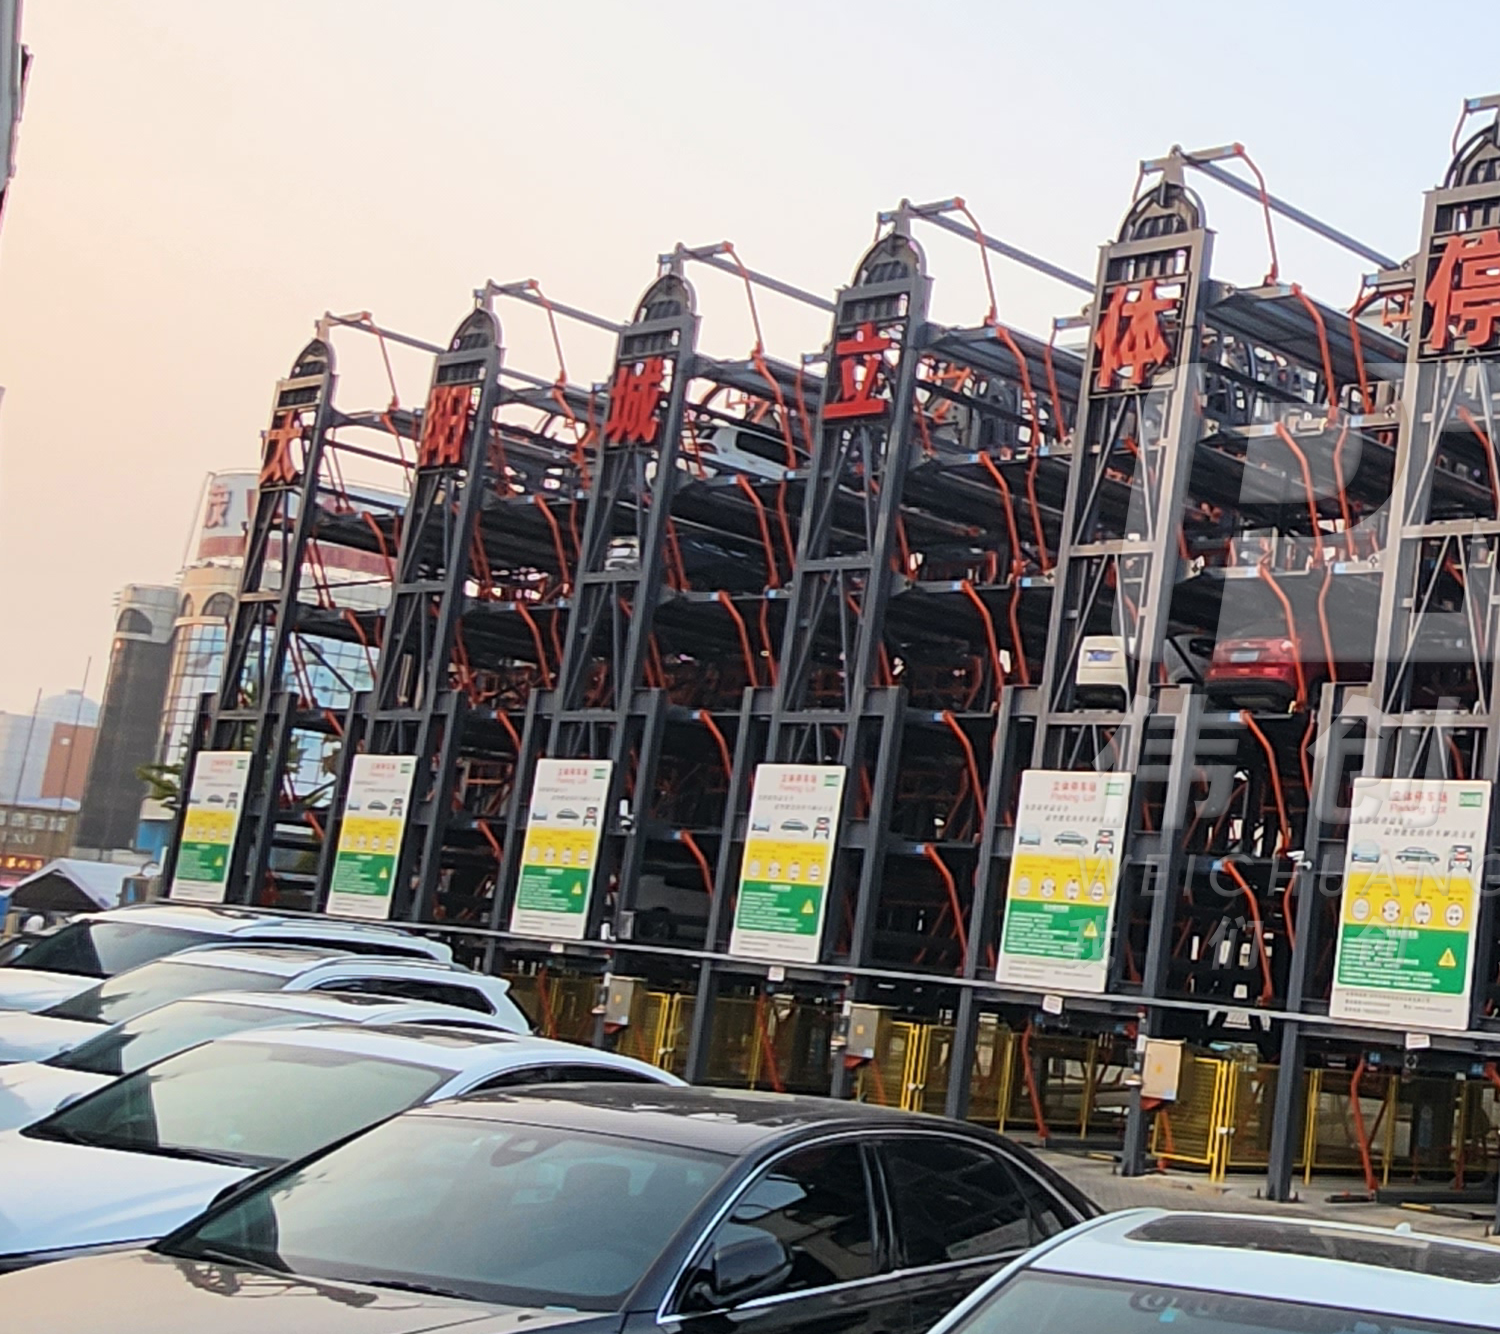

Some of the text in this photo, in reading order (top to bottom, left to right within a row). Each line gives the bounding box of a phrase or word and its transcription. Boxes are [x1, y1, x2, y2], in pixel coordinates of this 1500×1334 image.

[261, 411, 301, 480] 太
[420, 385, 471, 466] 阳
[605, 357, 663, 443] 城
[822, 322, 892, 419] 立
[1094, 278, 1175, 388] 体
